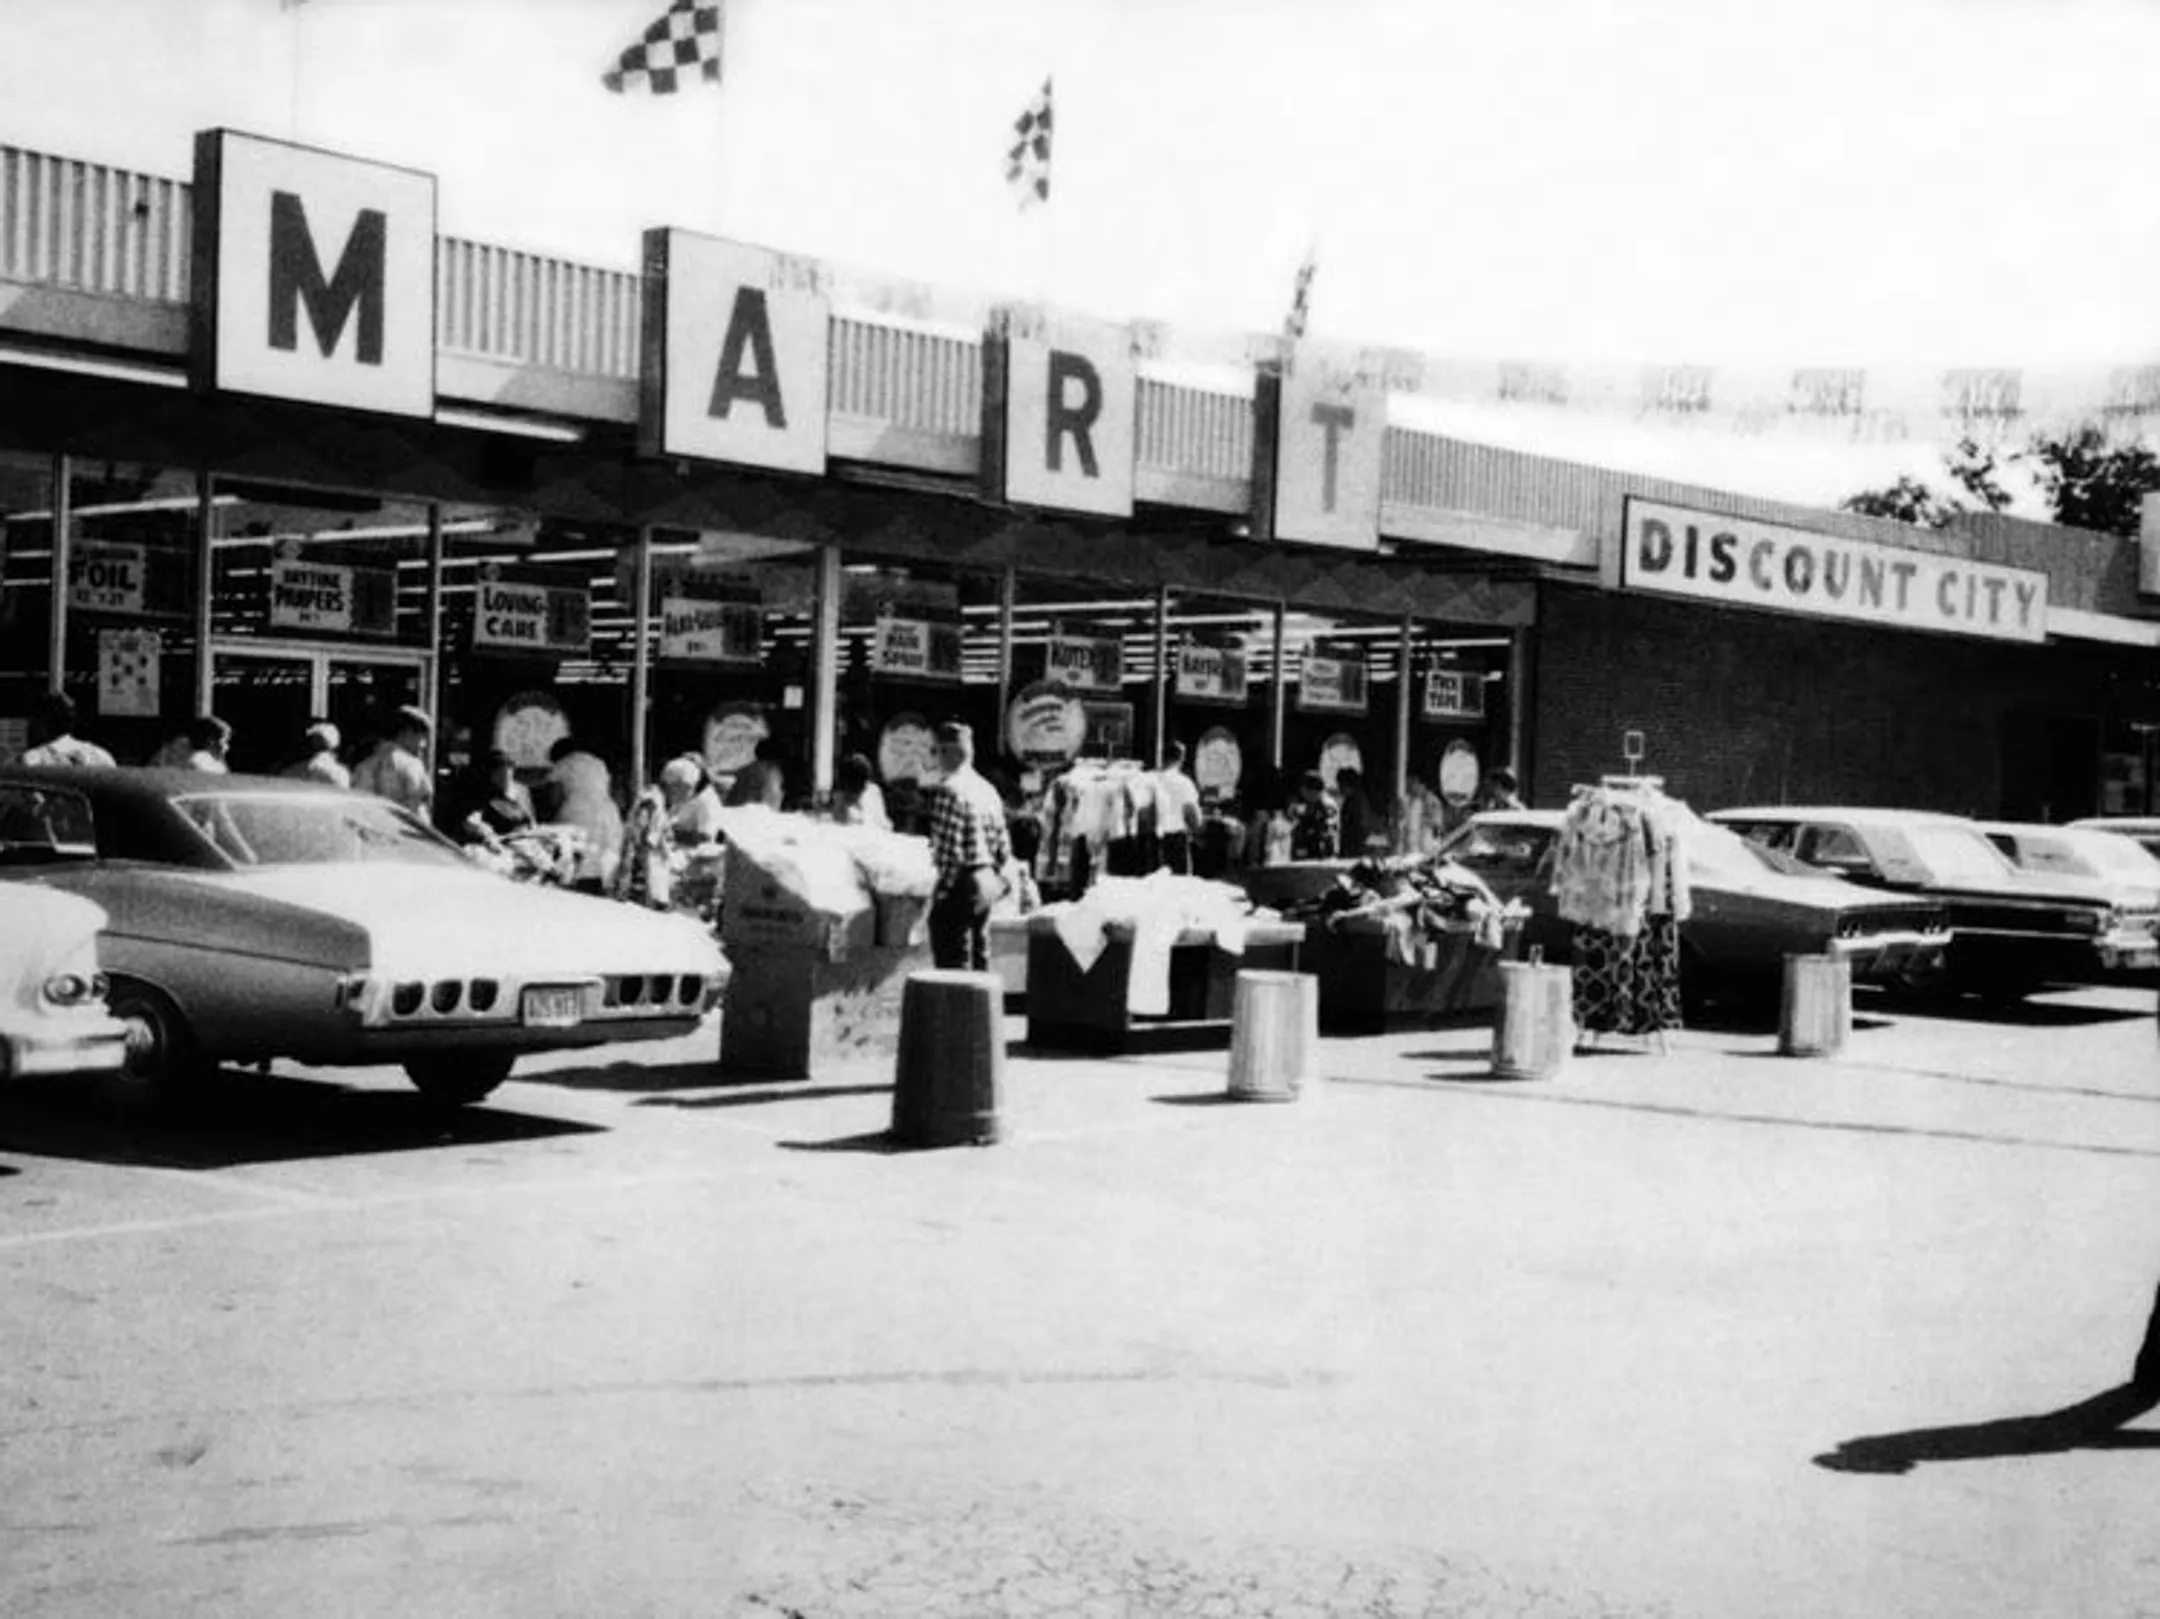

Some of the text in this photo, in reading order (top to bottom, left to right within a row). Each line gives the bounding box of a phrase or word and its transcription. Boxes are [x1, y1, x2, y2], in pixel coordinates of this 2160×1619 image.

[268, 190, 1355, 513] M A R T
[69, 558, 137, 592] FOIL
[1639, 518, 2037, 629] DISCOUNT CITY
[276, 583, 343, 612] PAMPERS
[484, 585, 546, 615] LOVING
[486, 616, 536, 640] CARE
